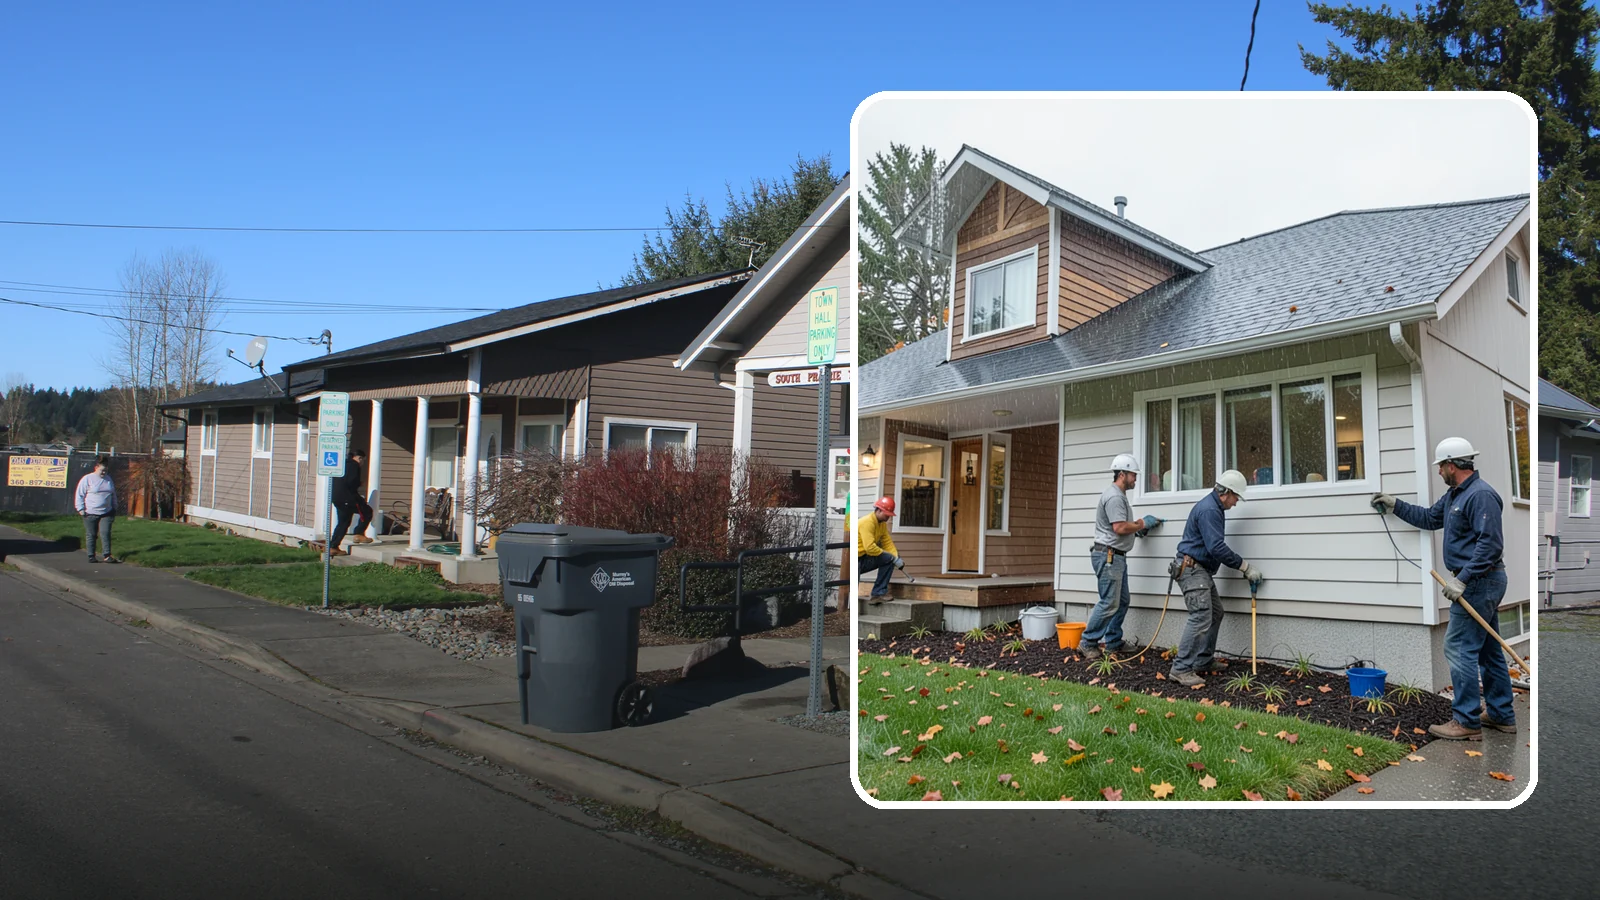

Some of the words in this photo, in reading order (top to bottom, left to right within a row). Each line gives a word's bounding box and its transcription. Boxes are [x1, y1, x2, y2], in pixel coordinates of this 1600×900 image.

[815, 295, 833, 308] TOWN
[814, 312, 832, 325] HALL
[810, 327, 836, 341] PARKING
[813, 344, 831, 358] ONLY
[775, 373, 801, 384] SOUTH
[323, 409, 345, 417] PARKING
[325, 420, 340, 428] ONLY
[320, 436, 344, 444] RESERVED
[321, 443, 342, 451] PARKING
[11, 457, 26, 466] COAST
